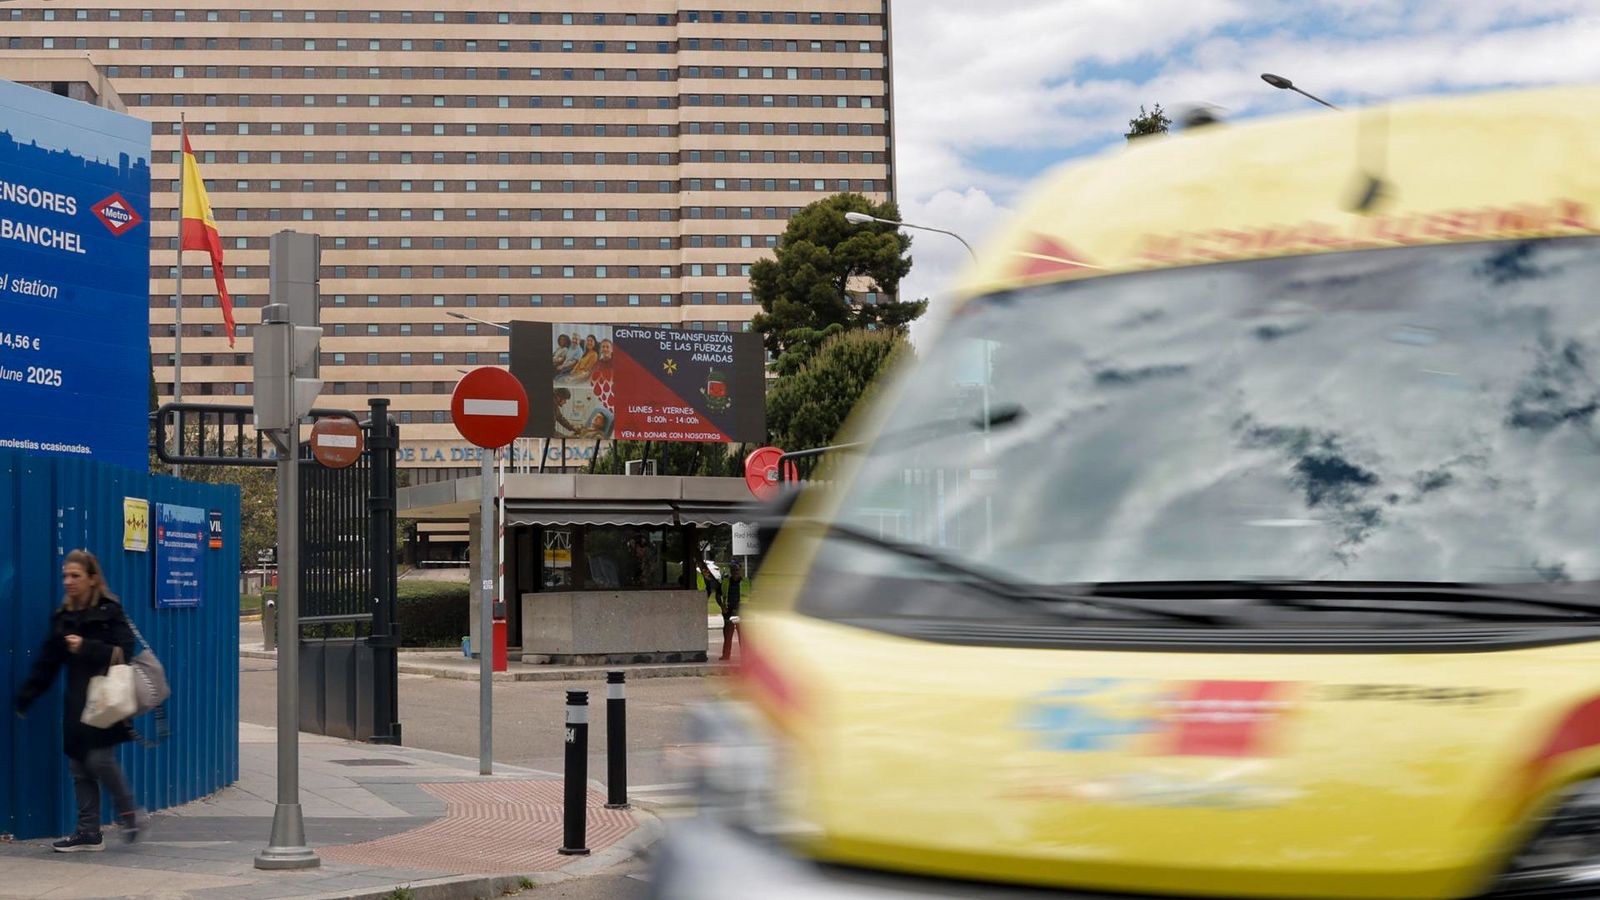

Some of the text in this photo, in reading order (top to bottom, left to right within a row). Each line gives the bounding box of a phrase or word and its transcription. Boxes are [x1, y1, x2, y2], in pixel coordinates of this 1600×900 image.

[0, 181, 77, 216] NSORES
[105, 207, 128, 221] Metro
[11, 278, 58, 299] station
[615, 329, 733, 343] CENTRO DE TRANSFUSIÓN
[32, 338, 40, 351] €
[660, 341, 733, 353] DE LAS FUERZAS
[691, 353, 733, 363] ARMADAS
[27, 366, 62, 387] 2025
[628, 405, 653, 414] LUNES
[662, 406, 694, 415] VIERNES
[647, 415, 667, 424] 8:00h
[675, 416, 699, 425] 14:00h
[621, 430, 635, 438] VEN
[644, 431, 667, 439] DONAR
[684, 432, 720, 440] NOSOTROS
[40, 442, 92, 454] ocasionadas.
[420, 447, 446, 462] LA
